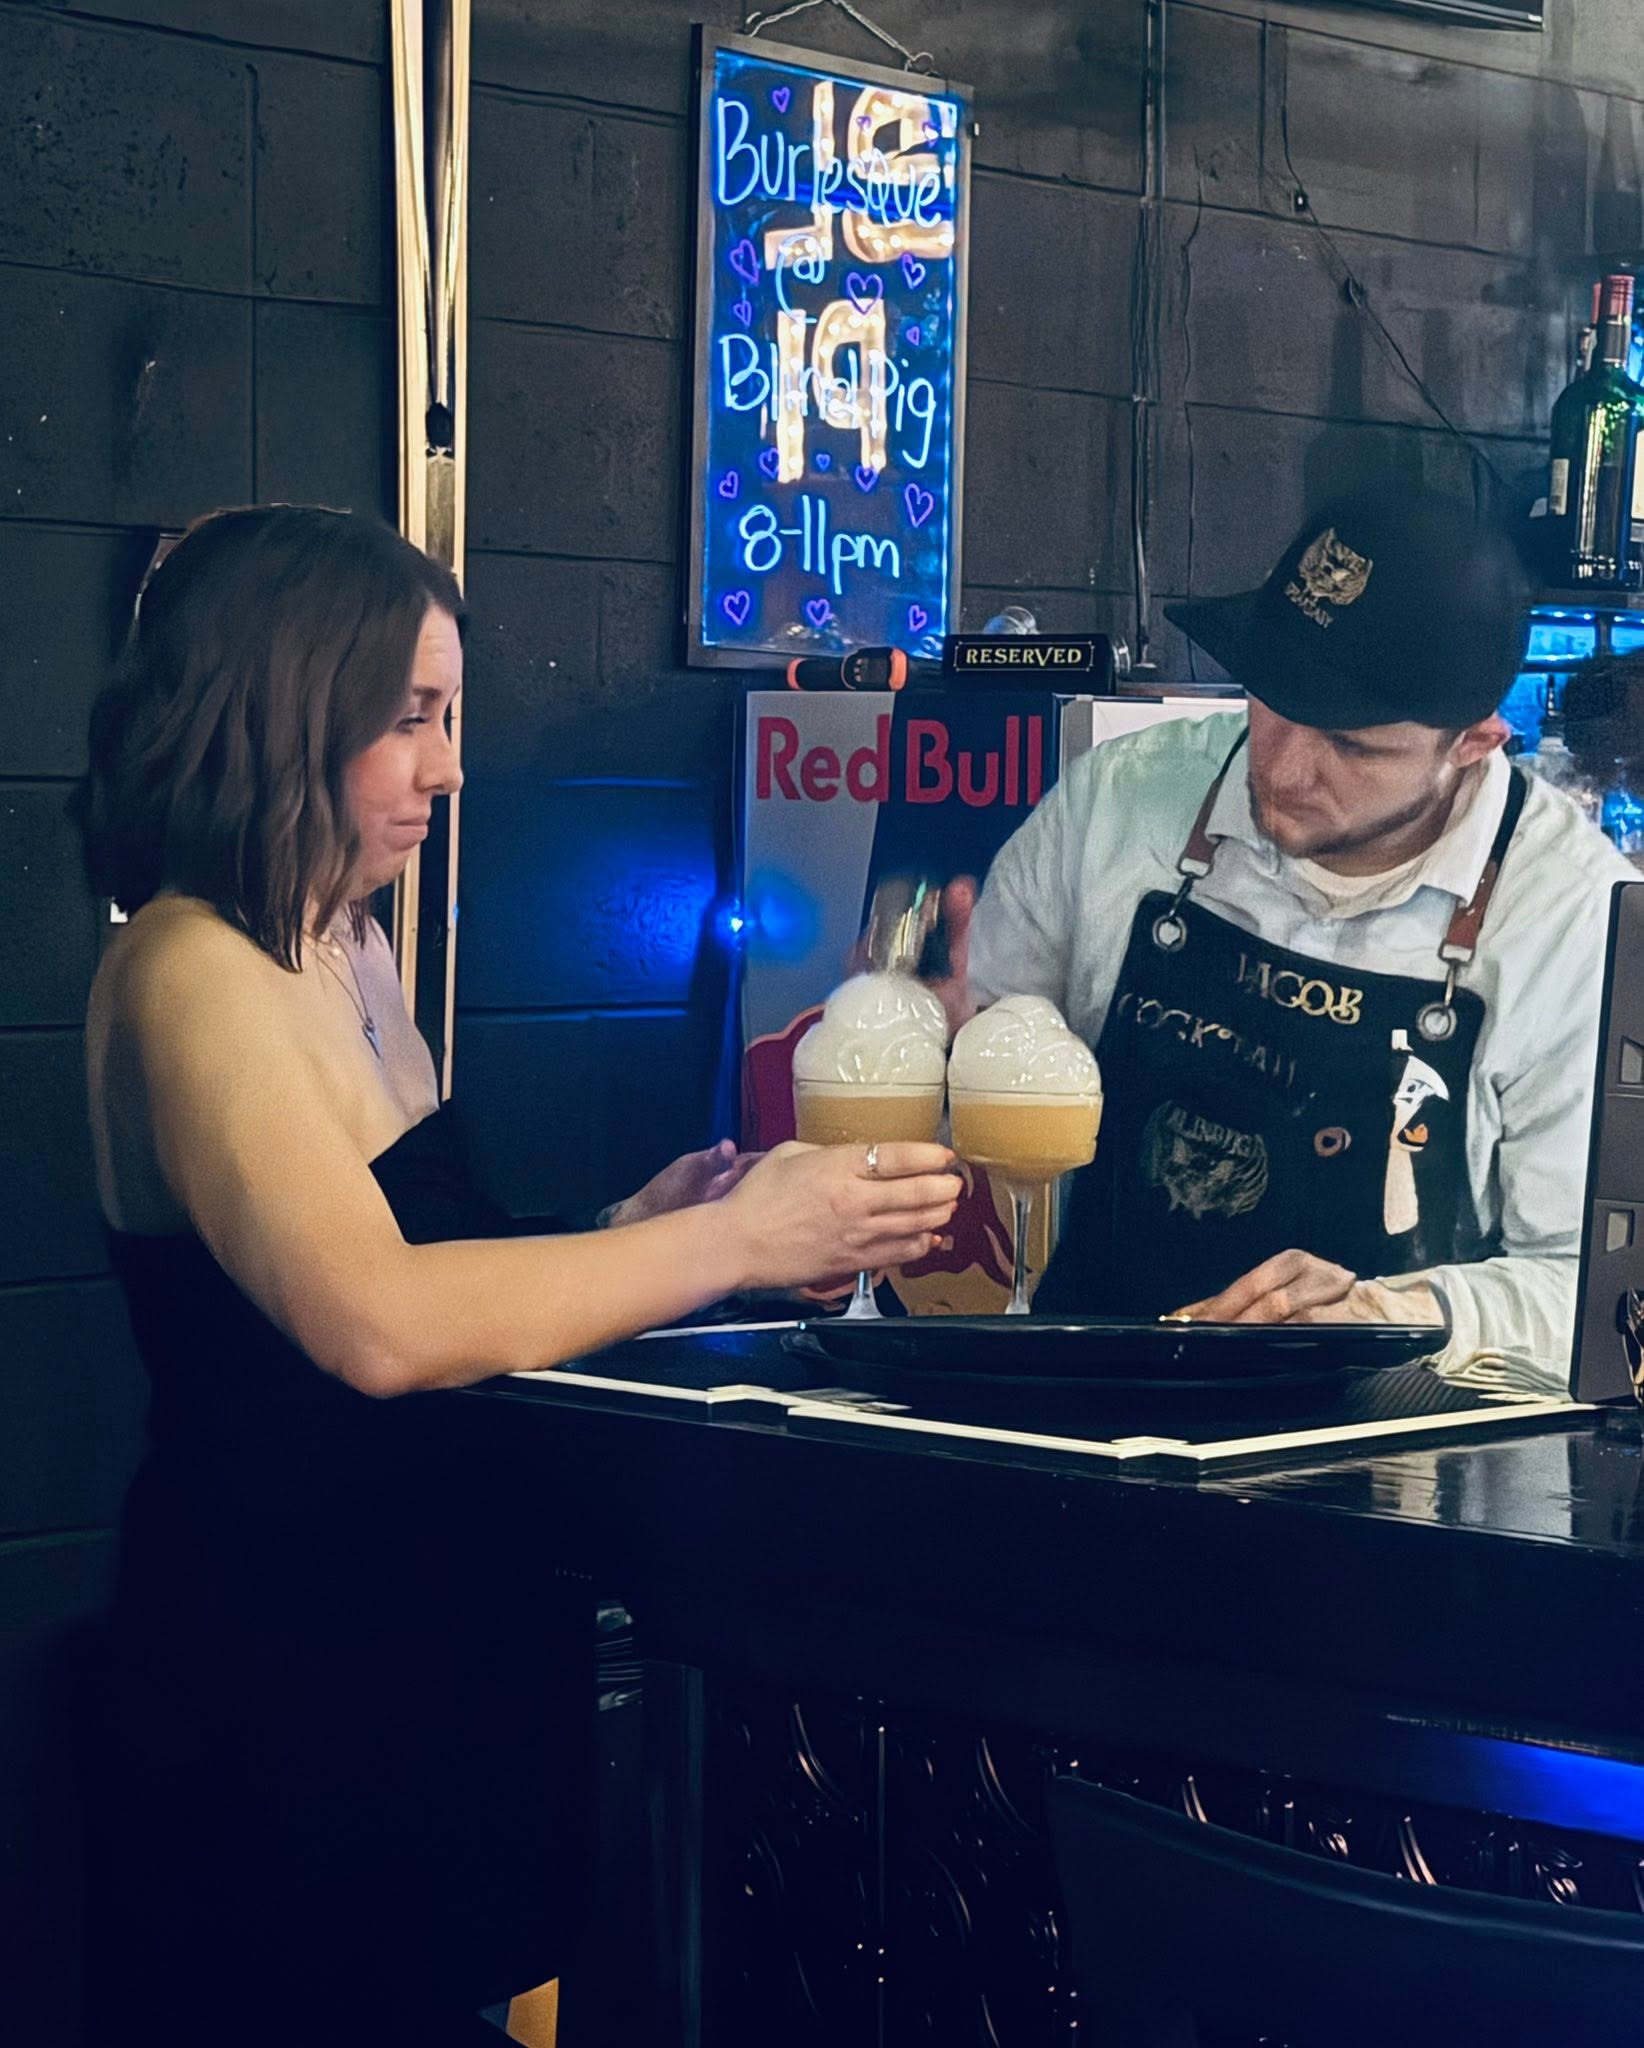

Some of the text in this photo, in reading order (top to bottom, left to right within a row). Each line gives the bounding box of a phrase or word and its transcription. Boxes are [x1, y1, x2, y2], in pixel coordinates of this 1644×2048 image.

[738, 494, 900, 595] 8-11pm
[965, 645, 1082, 668] RESERVED
[756, 712, 1043, 808] Red Bull
